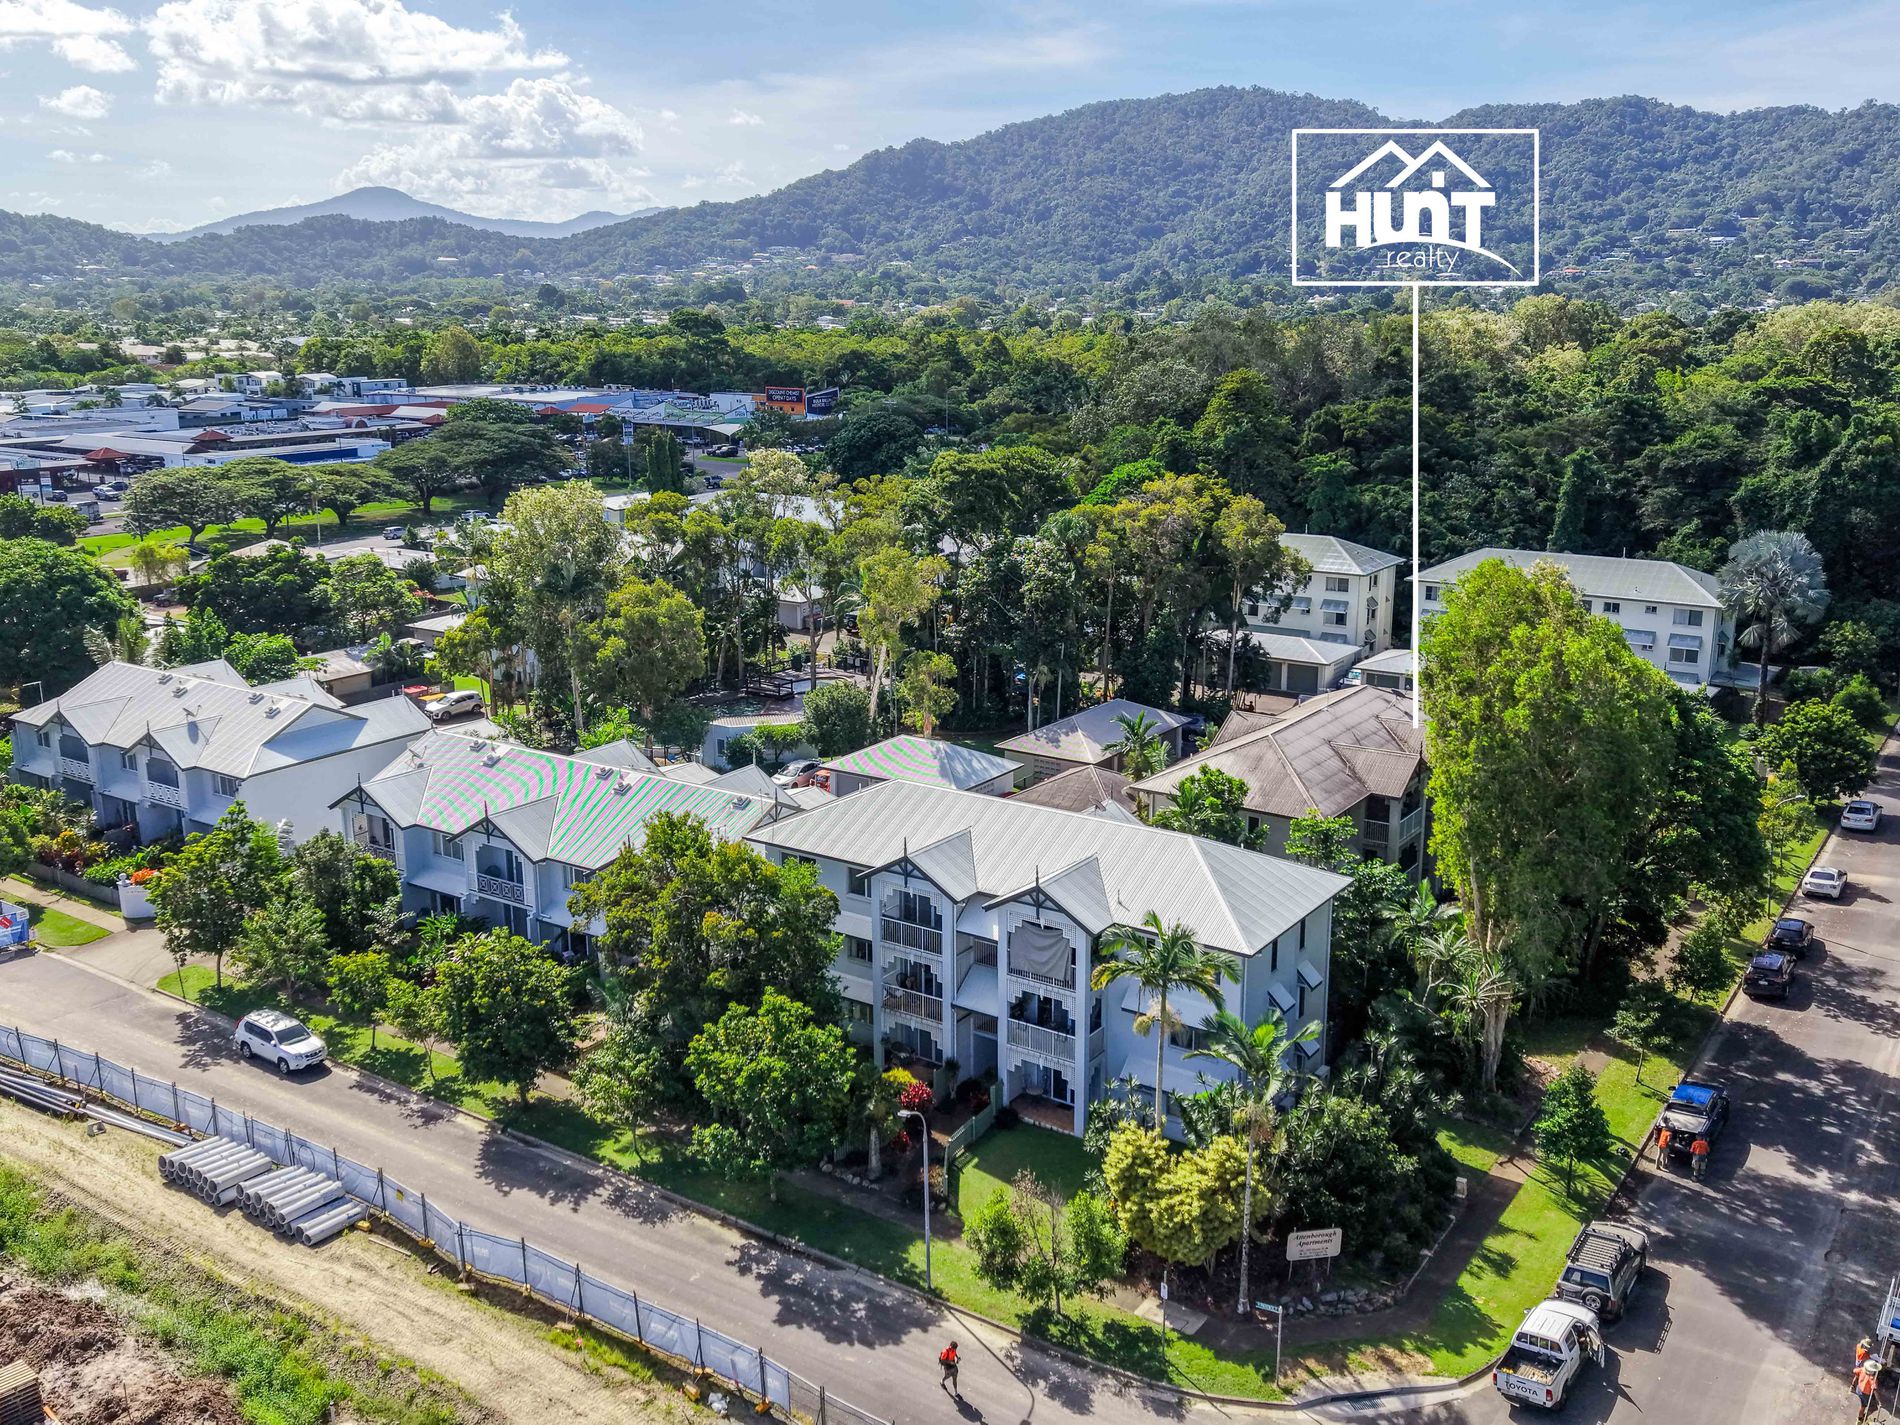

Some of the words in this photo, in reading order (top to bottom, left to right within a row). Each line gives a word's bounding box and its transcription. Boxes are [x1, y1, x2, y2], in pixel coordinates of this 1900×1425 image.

[1294, 1230, 1337, 1240] Attenborough
[1298, 1239, 1333, 1248] Apartments
[1505, 1381, 1538, 1396] TOYOTA
